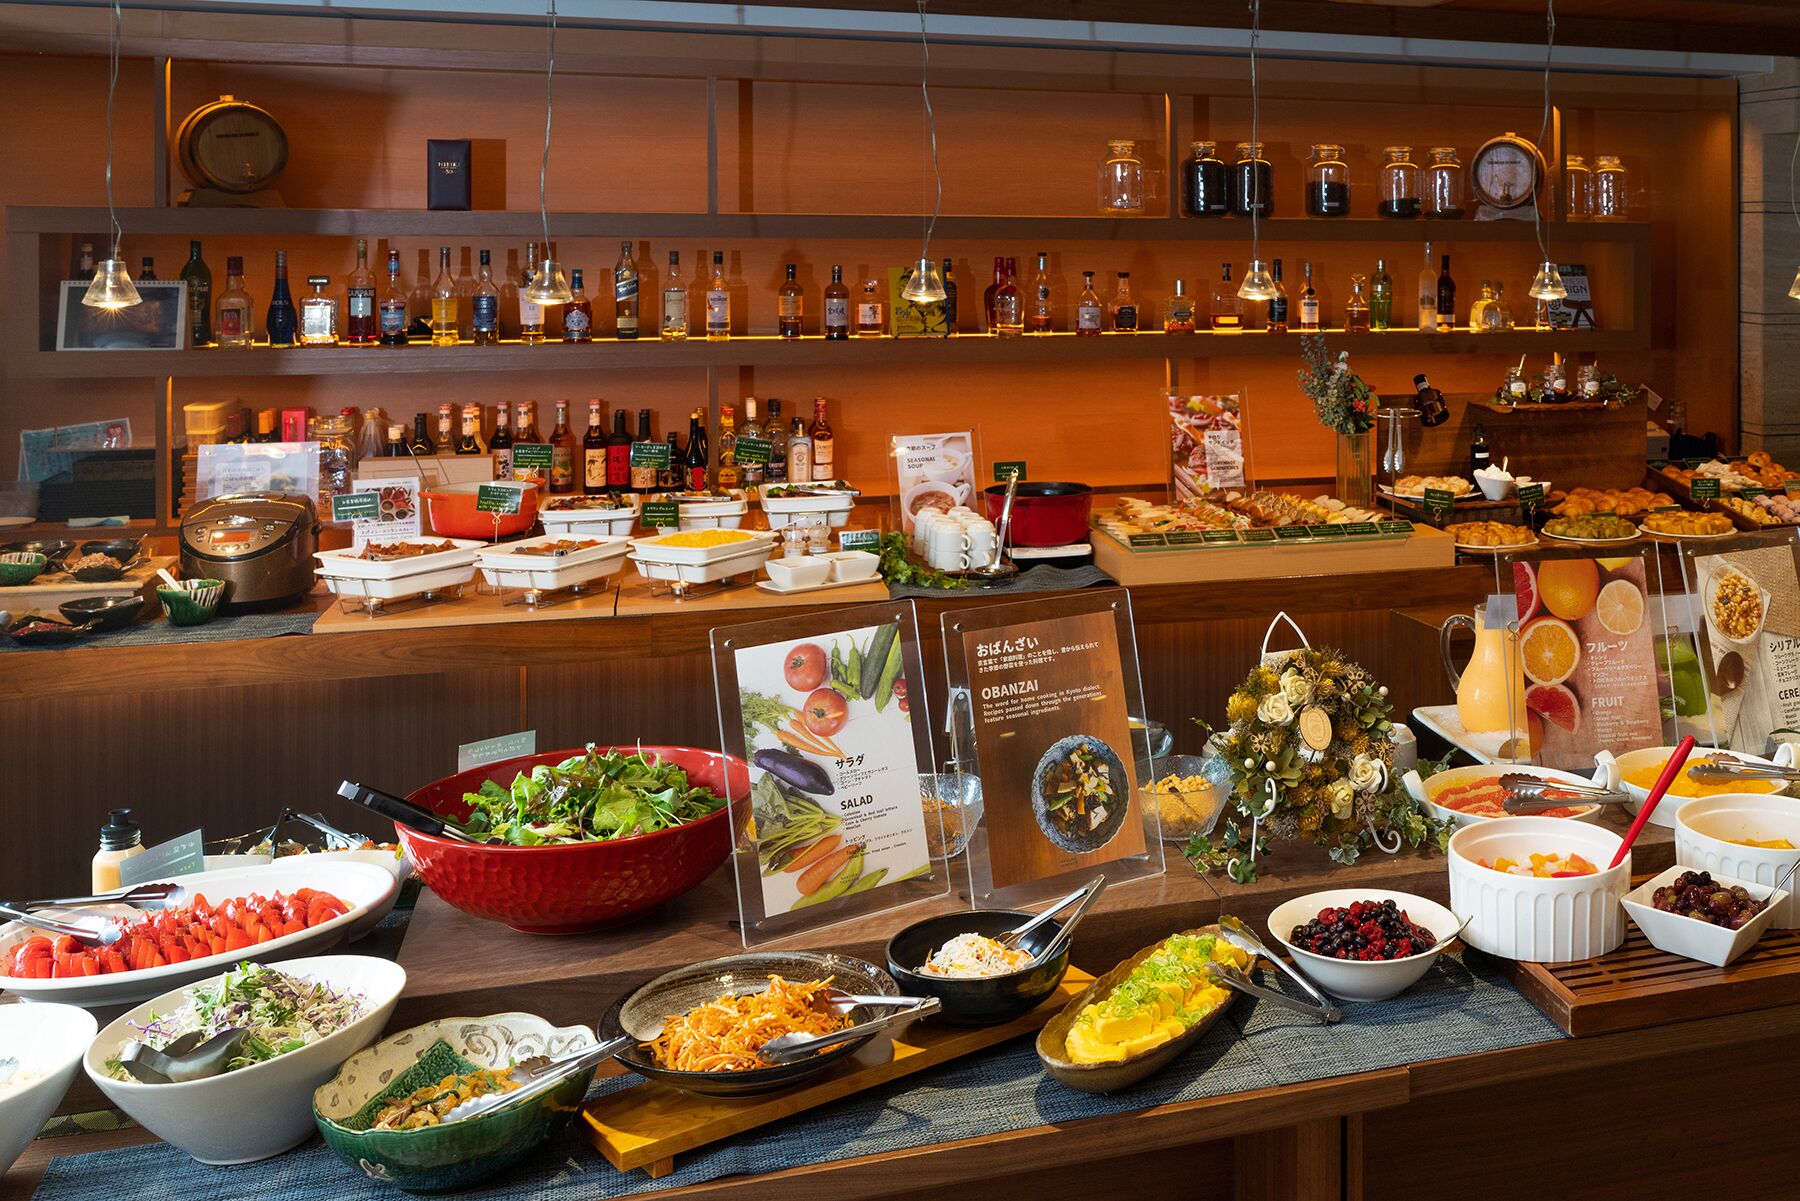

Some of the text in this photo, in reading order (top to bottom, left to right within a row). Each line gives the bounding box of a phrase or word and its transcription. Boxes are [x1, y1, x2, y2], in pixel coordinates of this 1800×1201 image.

[1564, 285, 1588, 294] SIGN
[977, 636, 1039, 657] おばんざい
[1586, 640, 1628, 653] フルーツ
[1770, 639, 1800, 653] シリアル
[981, 679, 1039, 700] OBANZAI
[995, 700, 1009, 708] word
[1036, 692, 1058, 701] cooking
[1066, 686, 1081, 695] Kyoto
[983, 708, 1004, 717] Recipes
[1005, 705, 1024, 714] passed
[1024, 701, 1039, 709] down
[1040, 698, 1061, 707] through
[1073, 691, 1102, 701] generations
[1592, 695, 1624, 708] FRUIT
[984, 706, 1061, 723] feature seasonal ingredients.
[835, 753, 864, 769] サラダ
[840, 794, 873, 810] SALAD
